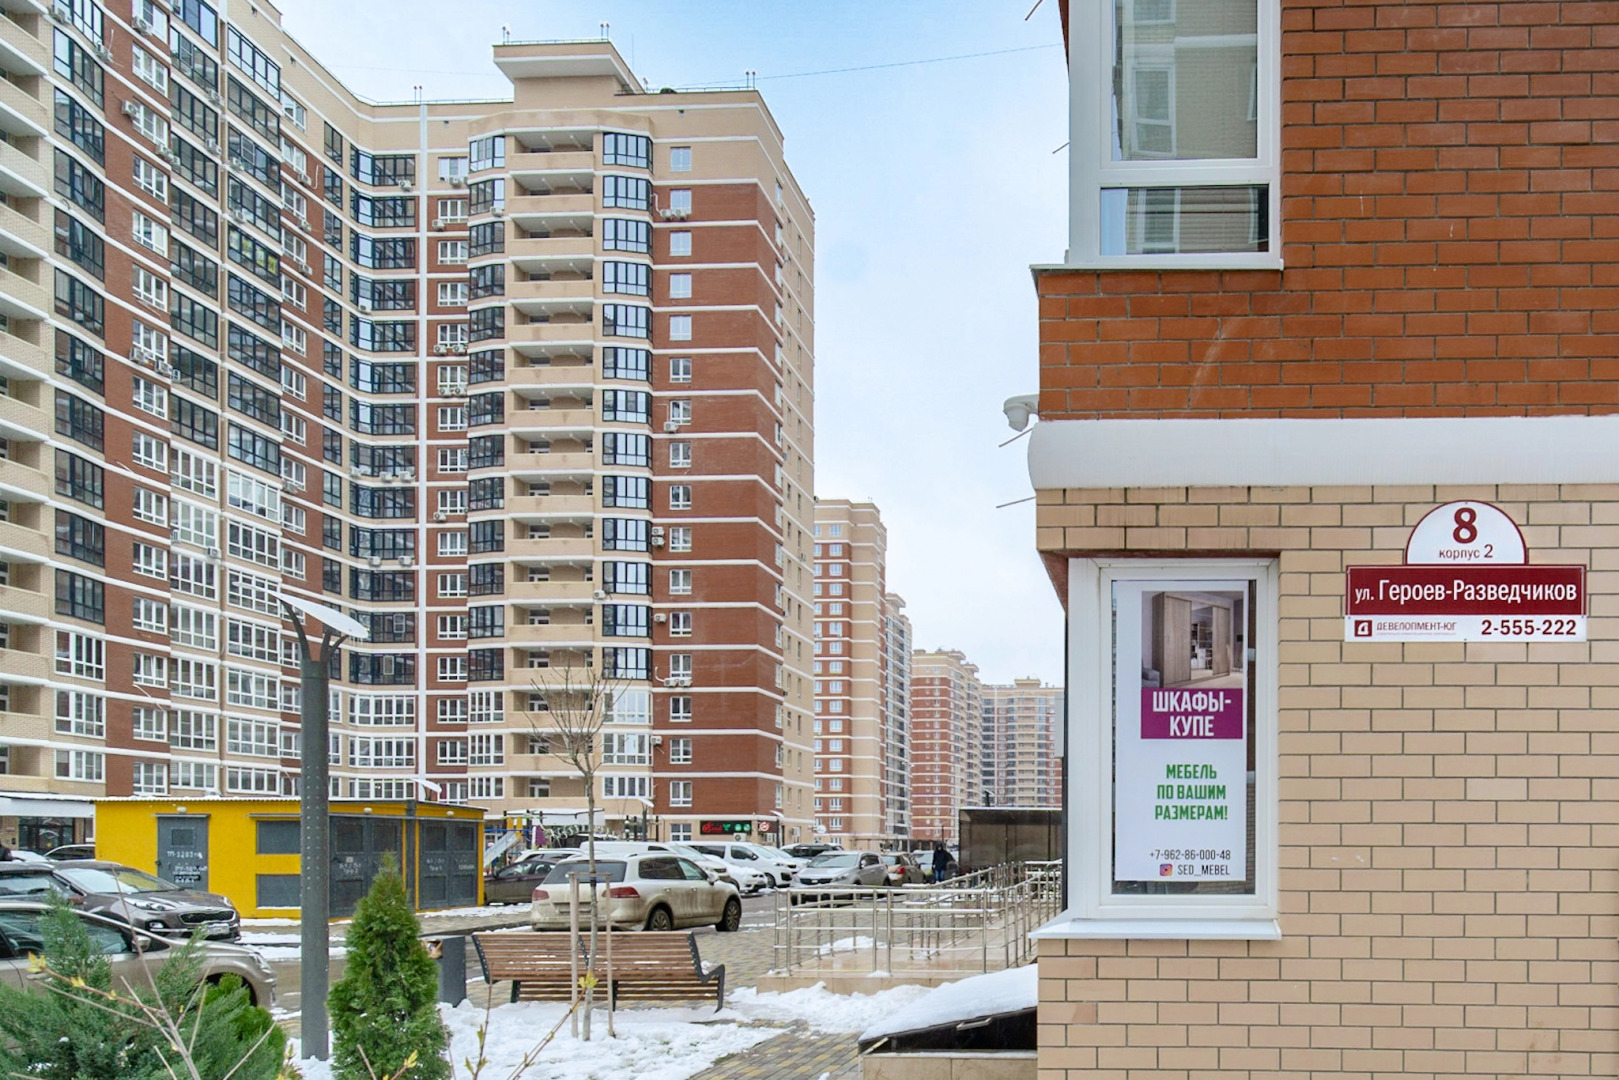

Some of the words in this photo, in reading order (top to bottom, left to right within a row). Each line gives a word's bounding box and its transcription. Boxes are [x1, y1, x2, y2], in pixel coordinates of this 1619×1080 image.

[1453, 508, 1477, 544] 8
[1439, 548, 1480, 559] корпус
[1484, 545, 1493, 558] 2
[1355, 588, 1374, 603] ул.
[1379, 580, 1577, 604] Героев-Разведчиков
[1377, 622, 1457, 630] ДЕВЕЛОПМЕНТ-ЮГ
[1481, 620, 1576, 635] 2-555-222
[1153, 692, 1231, 712] ШКАФЫ-
[1170, 717, 1214, 736] КУПЕ
[1166, 764, 1217, 779] МЕБЕЛЬ
[1157, 785, 1173, 799] ПО
[1178, 785, 1226, 800] ВАШИМ
[1155, 806, 1228, 820] РАЗМЕРАМ!
[1150, 849, 1231, 860] +7-962-86-000-48
